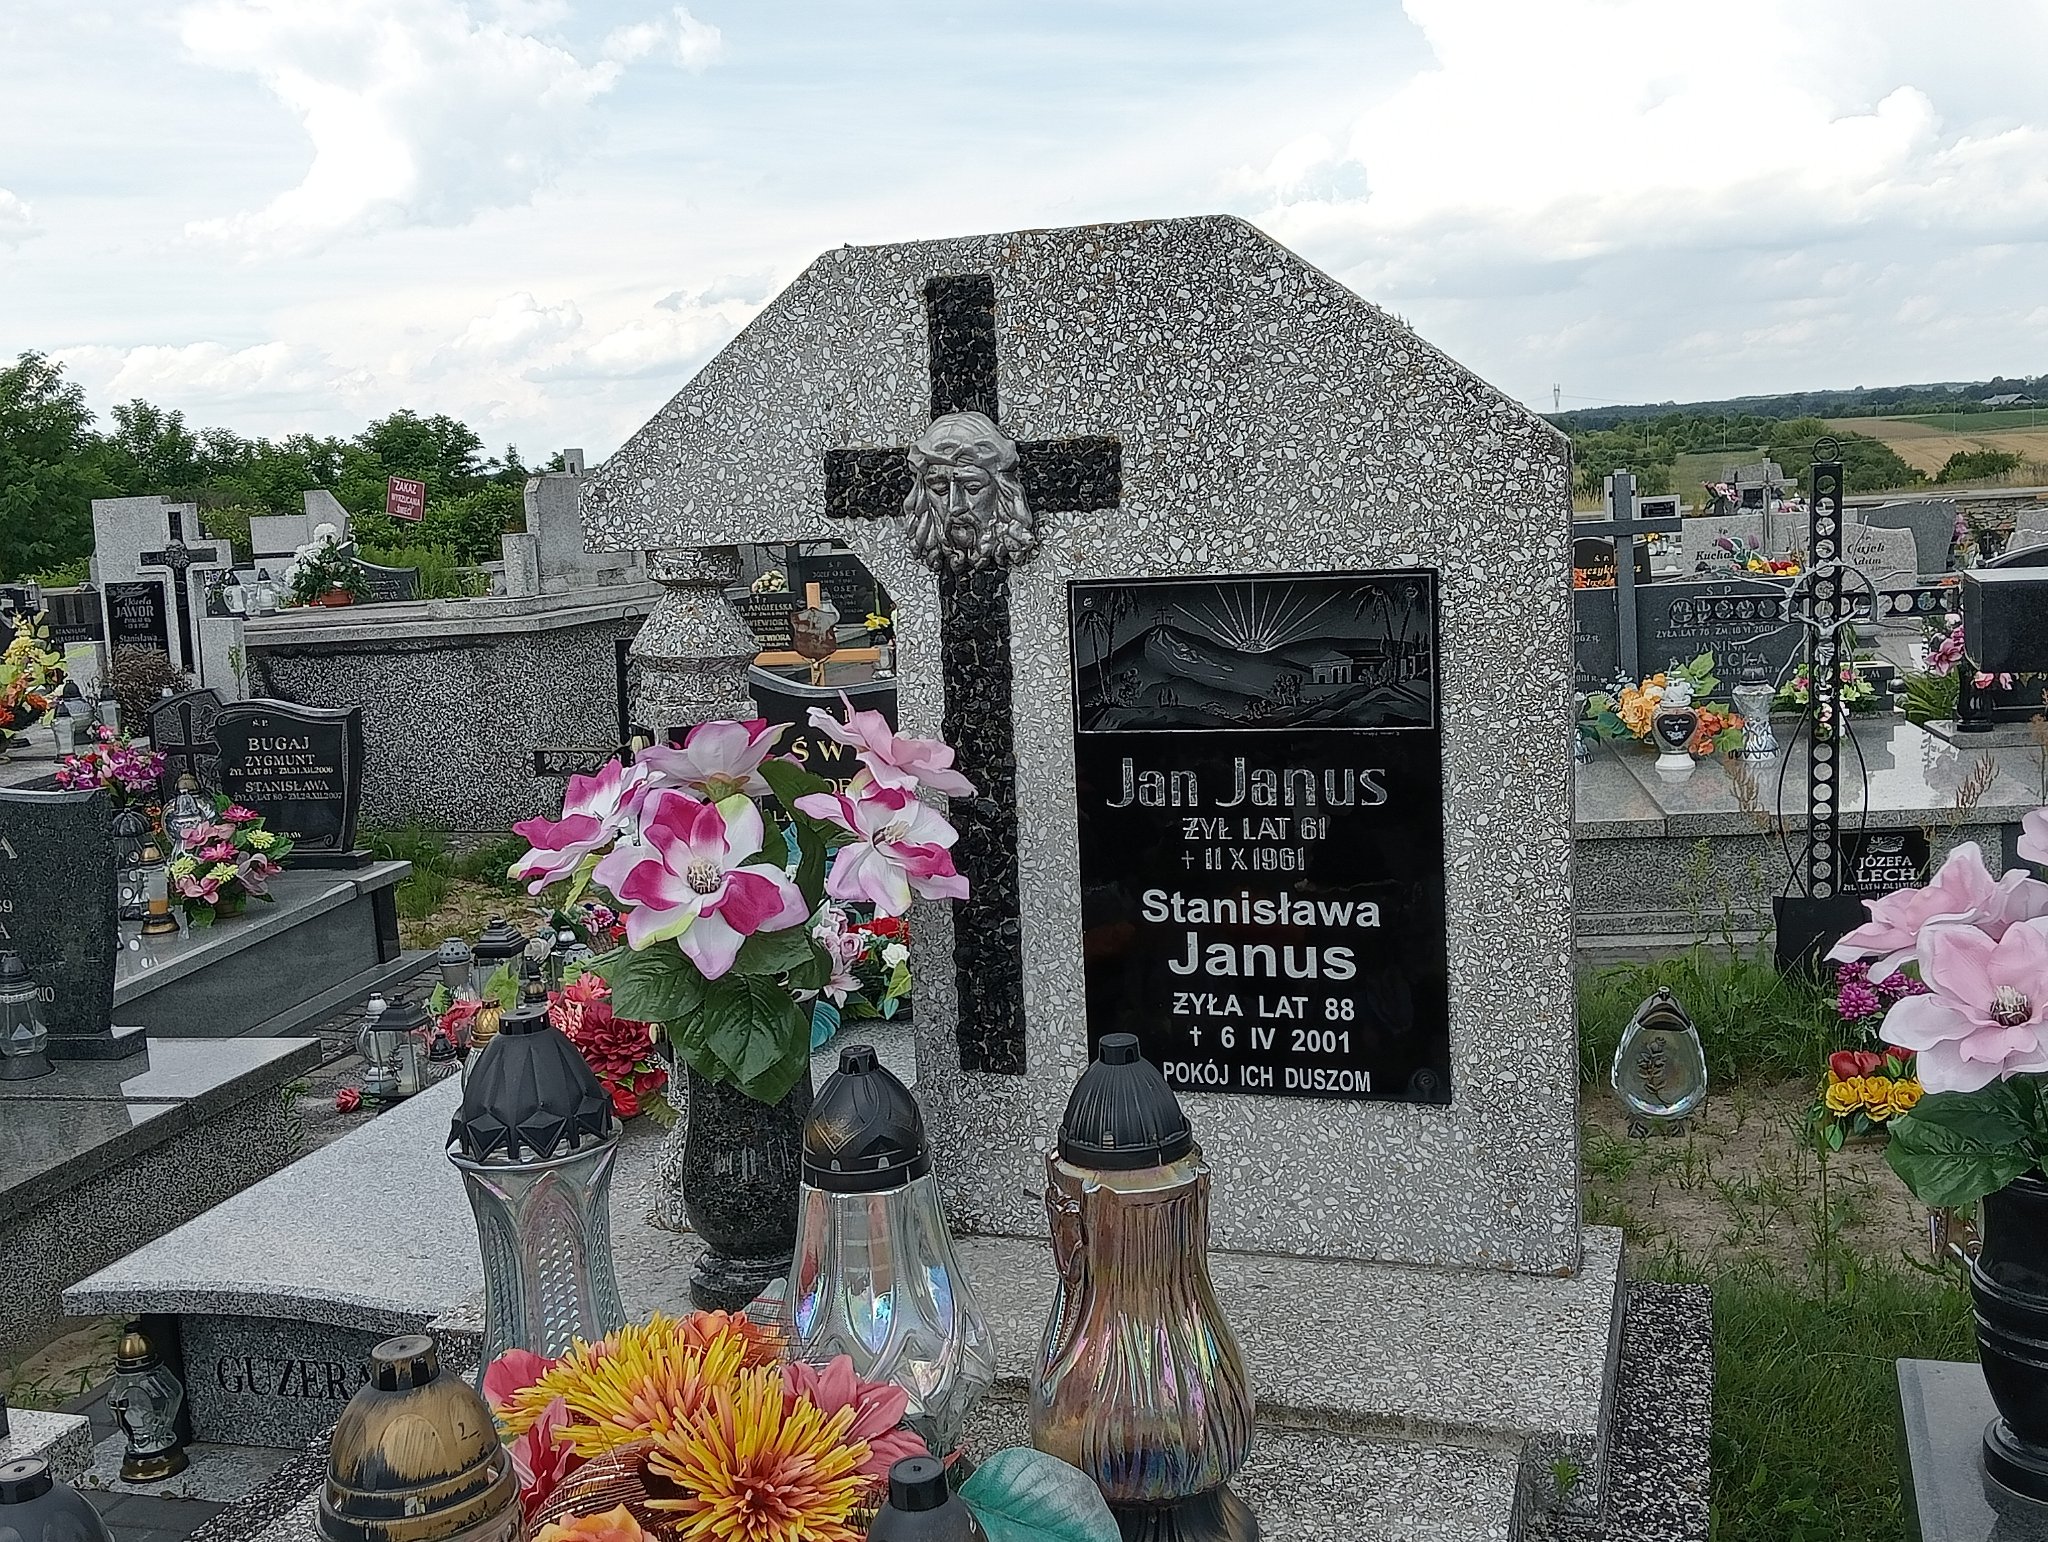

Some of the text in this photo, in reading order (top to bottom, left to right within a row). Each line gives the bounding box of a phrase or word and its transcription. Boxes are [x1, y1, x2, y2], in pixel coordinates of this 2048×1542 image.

[393, 479, 417, 495] ZAKAZ
[832, 569, 857, 577] OSET
[114, 605, 155, 618] JAWOR
[748, 603, 793, 612] ANGIELSKA
[248, 736, 310, 751] BUGAJ
[244, 754, 315, 767] ZYGMUNT
[247, 767, 262, 776] LAT
[245, 780, 330, 793] STANISŁAWA
[1107, 757, 1388, 808] Jan Janus
[258, 792, 272, 801] LAT
[1243, 817, 1291, 840] LAT
[1301, 816, 1326, 840] 61
[1228, 847, 1248, 871] X
[1253, 846, 1305, 871] 1961
[1859, 854, 1912, 869] JÓZEFA
[1856, 868, 1916, 882] LECH
[1142, 889, 1381, 928] Stanisława
[1168, 931, 1357, 980] Janus
[1258, 995, 1309, 1019] LAT
[1324, 998, 1355, 1021] 88
[1221, 1026, 1350, 1054] 6 IV 2001
[1163, 1058, 1371, 1093] POKÓJ ICH DUSZOM
